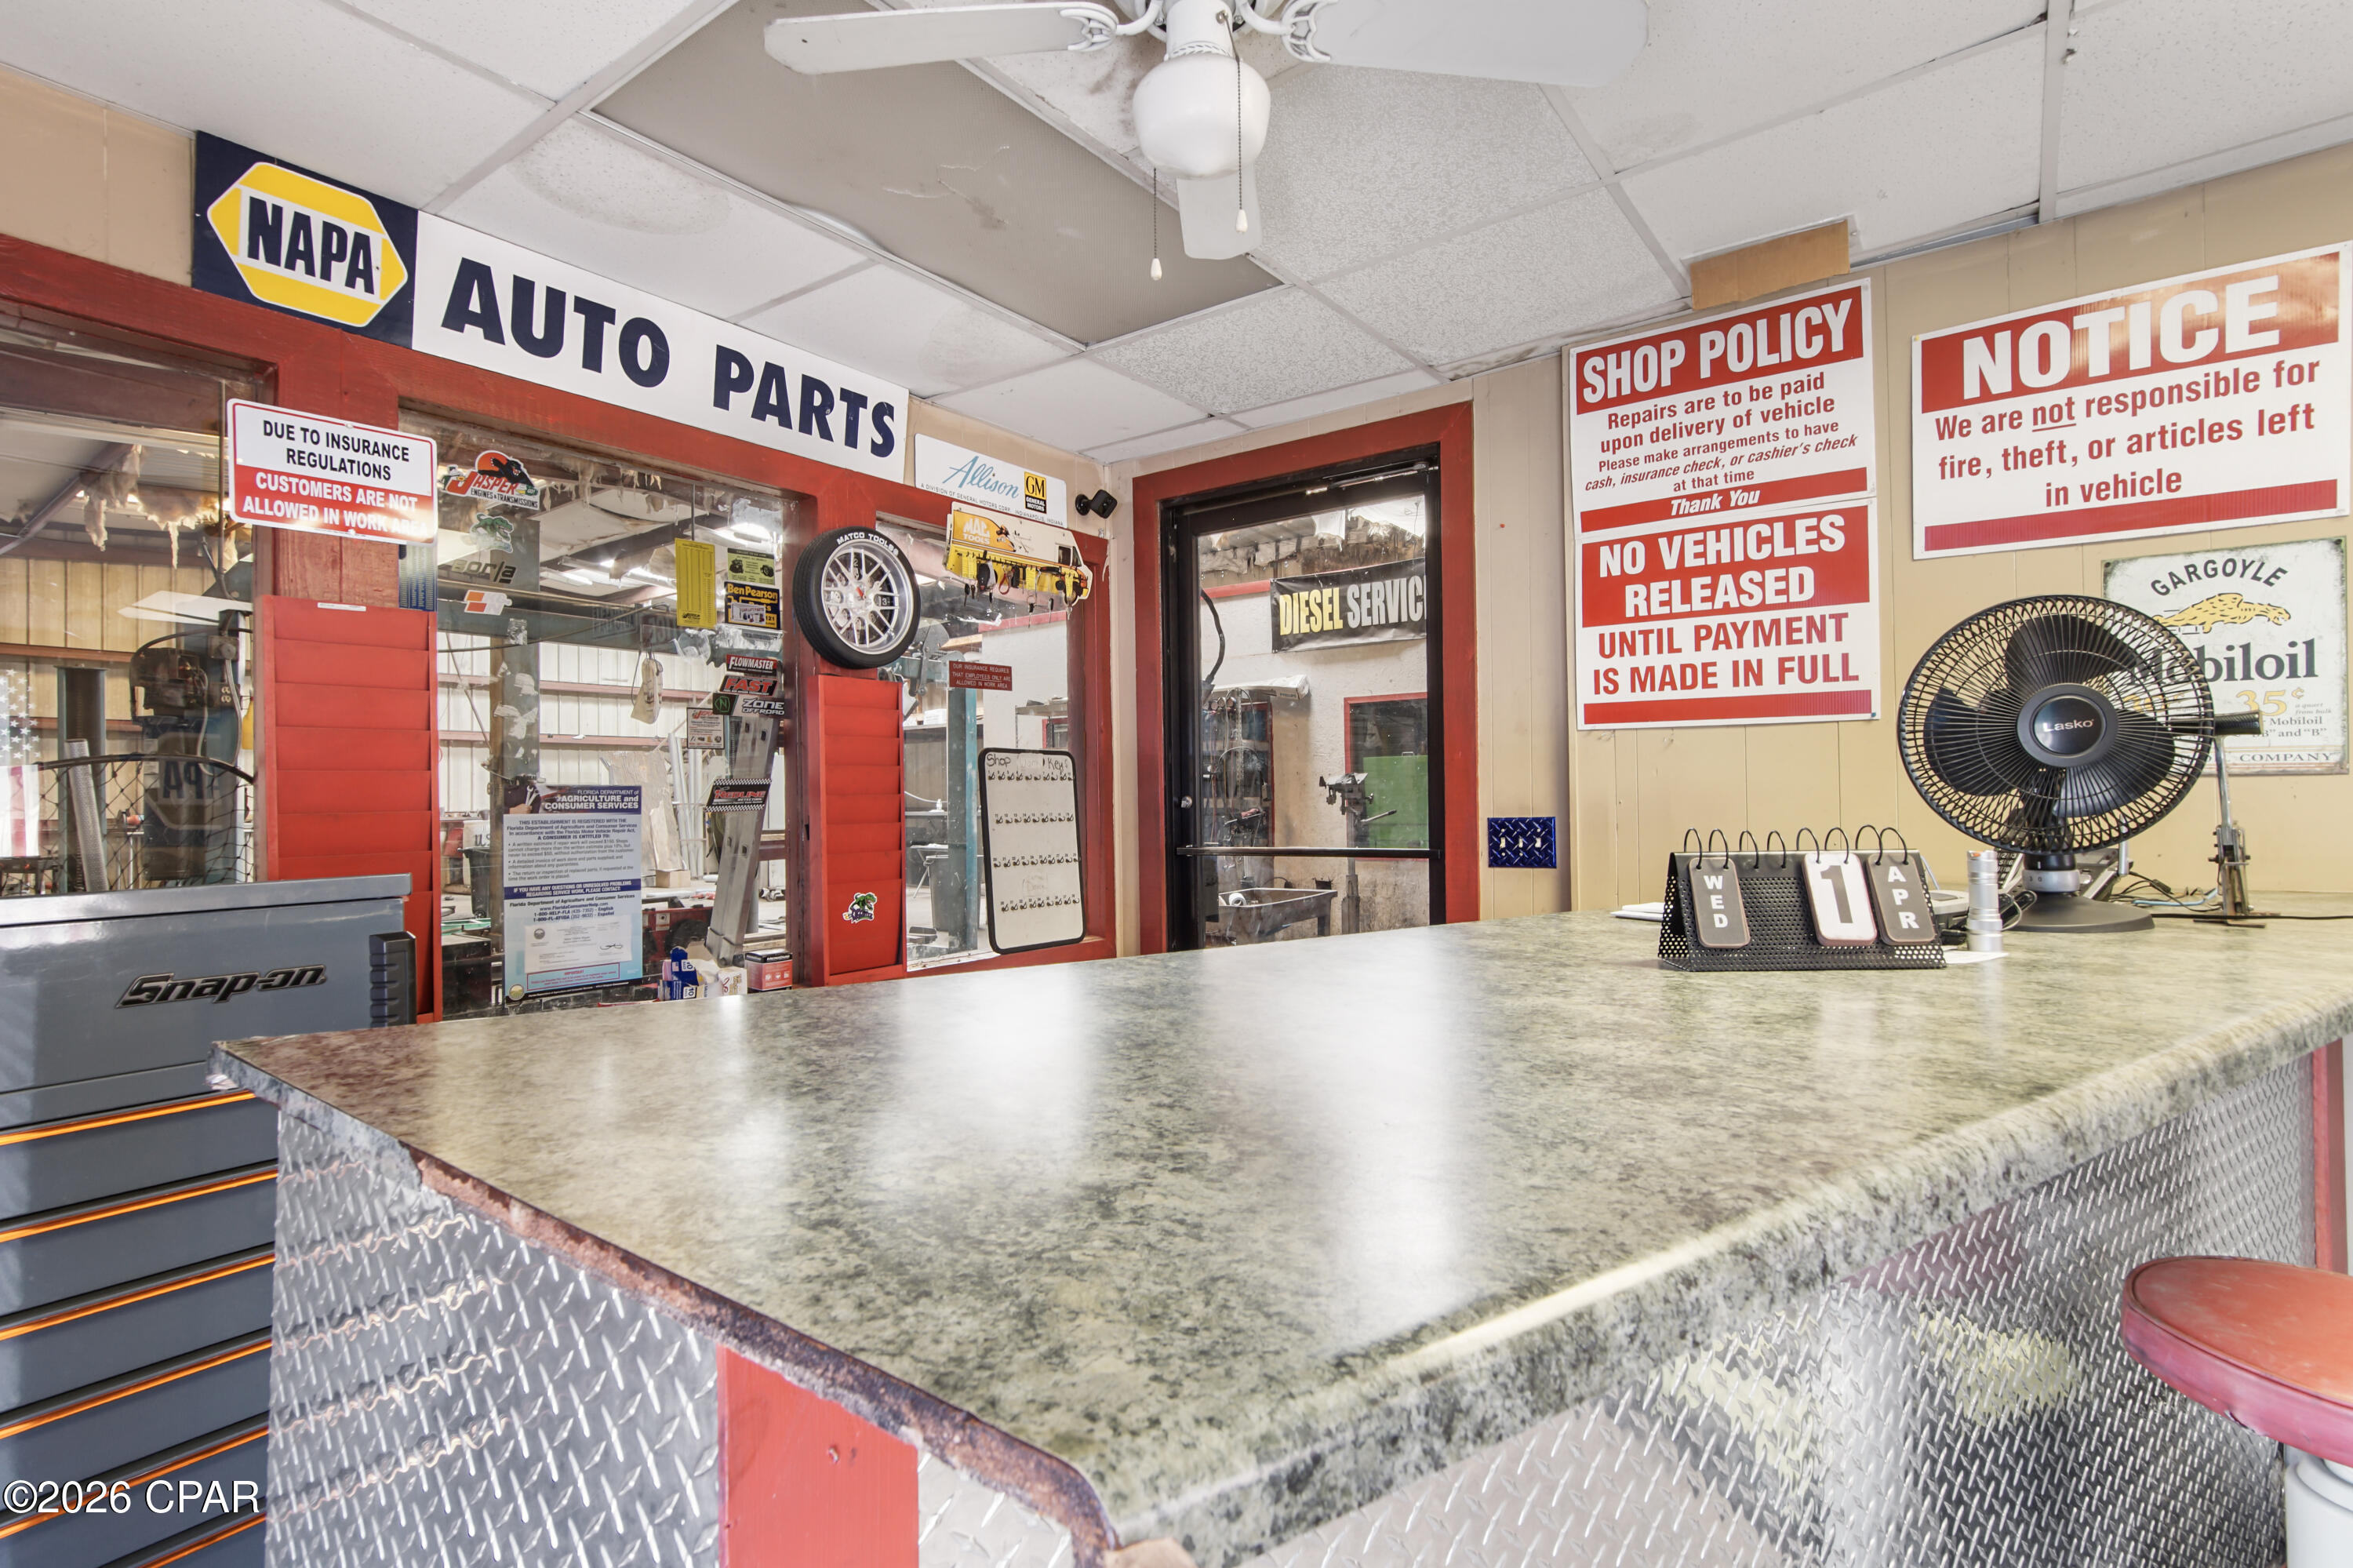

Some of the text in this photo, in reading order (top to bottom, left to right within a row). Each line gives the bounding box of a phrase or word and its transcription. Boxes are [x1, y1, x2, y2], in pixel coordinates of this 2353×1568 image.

[247, 196, 376, 294] NAPA
[441, 257, 896, 458] AUTO PARTS
[1583, 298, 1853, 403] SHOP POLICY
[1963, 275, 2280, 400] NOTICE
[1608, 372, 1824, 430] Repairs are to be paid
[1936, 359, 2320, 441] We are not responsible for
[264, 420, 409, 462] DUE TO INSURANCE
[1601, 396, 1835, 455] upon delivery of vehicle
[1939, 402, 2315, 480] fire, theft, or articles left
[286, 448, 391, 481] REGULATIONS
[1585, 434, 1859, 491] cash, insurance check, or cashier's check
[1599, 422, 1839, 472] Please make arrangements to have
[256, 471, 418, 511] CUSTOMERS ARE NOT
[446, 471, 519, 495] JASPER
[926, 484, 947, 495] DIVISION
[957, 493, 978, 503] GENERAL
[980, 499, 998, 509] MOTORS
[942, 456, 1020, 499] Allison
[1025, 475, 1045, 498] GM
[1674, 470, 1755, 492] at that time
[2046, 467, 2182, 508] in vehicle
[242, 496, 319, 522] ALLOWED
[323, 507, 340, 525] IN
[343, 511, 387, 533] WORK
[387, 517, 428, 537] AREA
[471, 488, 493, 499] ENGINES
[496, 493, 538, 508] TRANSMISSIONS
[1026, 496, 1046, 507] GENERAL
[1027, 502, 1045, 512] MOTORS
[1671, 489, 1760, 515] Thank You
[837, 532, 865, 544] MATCO
[962, 518, 990, 537] MAC
[962, 533, 990, 545] TOOLS
[1599, 514, 1846, 577] NO VEHICLES
[727, 583, 778, 599] Ben Pearson
[1625, 566, 1815, 617] RELEASED
[2150, 558, 2288, 596] GARGOYLE
[1279, 588, 1344, 635] DIESEL
[1598, 612, 1849, 659] UNTIL PAYMENT
[729, 657, 773, 670] FLOWMASTER
[1594, 653, 1859, 695] IS MADE IN FULL
[725, 678, 773, 693] FAST
[743, 698, 784, 709] ZONE
[2042, 719, 2093, 733] Lasko
[2270, 715, 2323, 726] Mobiloil
[2278, 728, 2301, 737] and
[987, 754, 1011, 767] Shop
[2240, 752, 2332, 762] COMPANY
[1704, 875, 1728, 928] WED
[1820, 865, 1853, 924] 1
[1888, 866, 1920, 929] APR
[115, 964, 326, 1009] Snap-on
